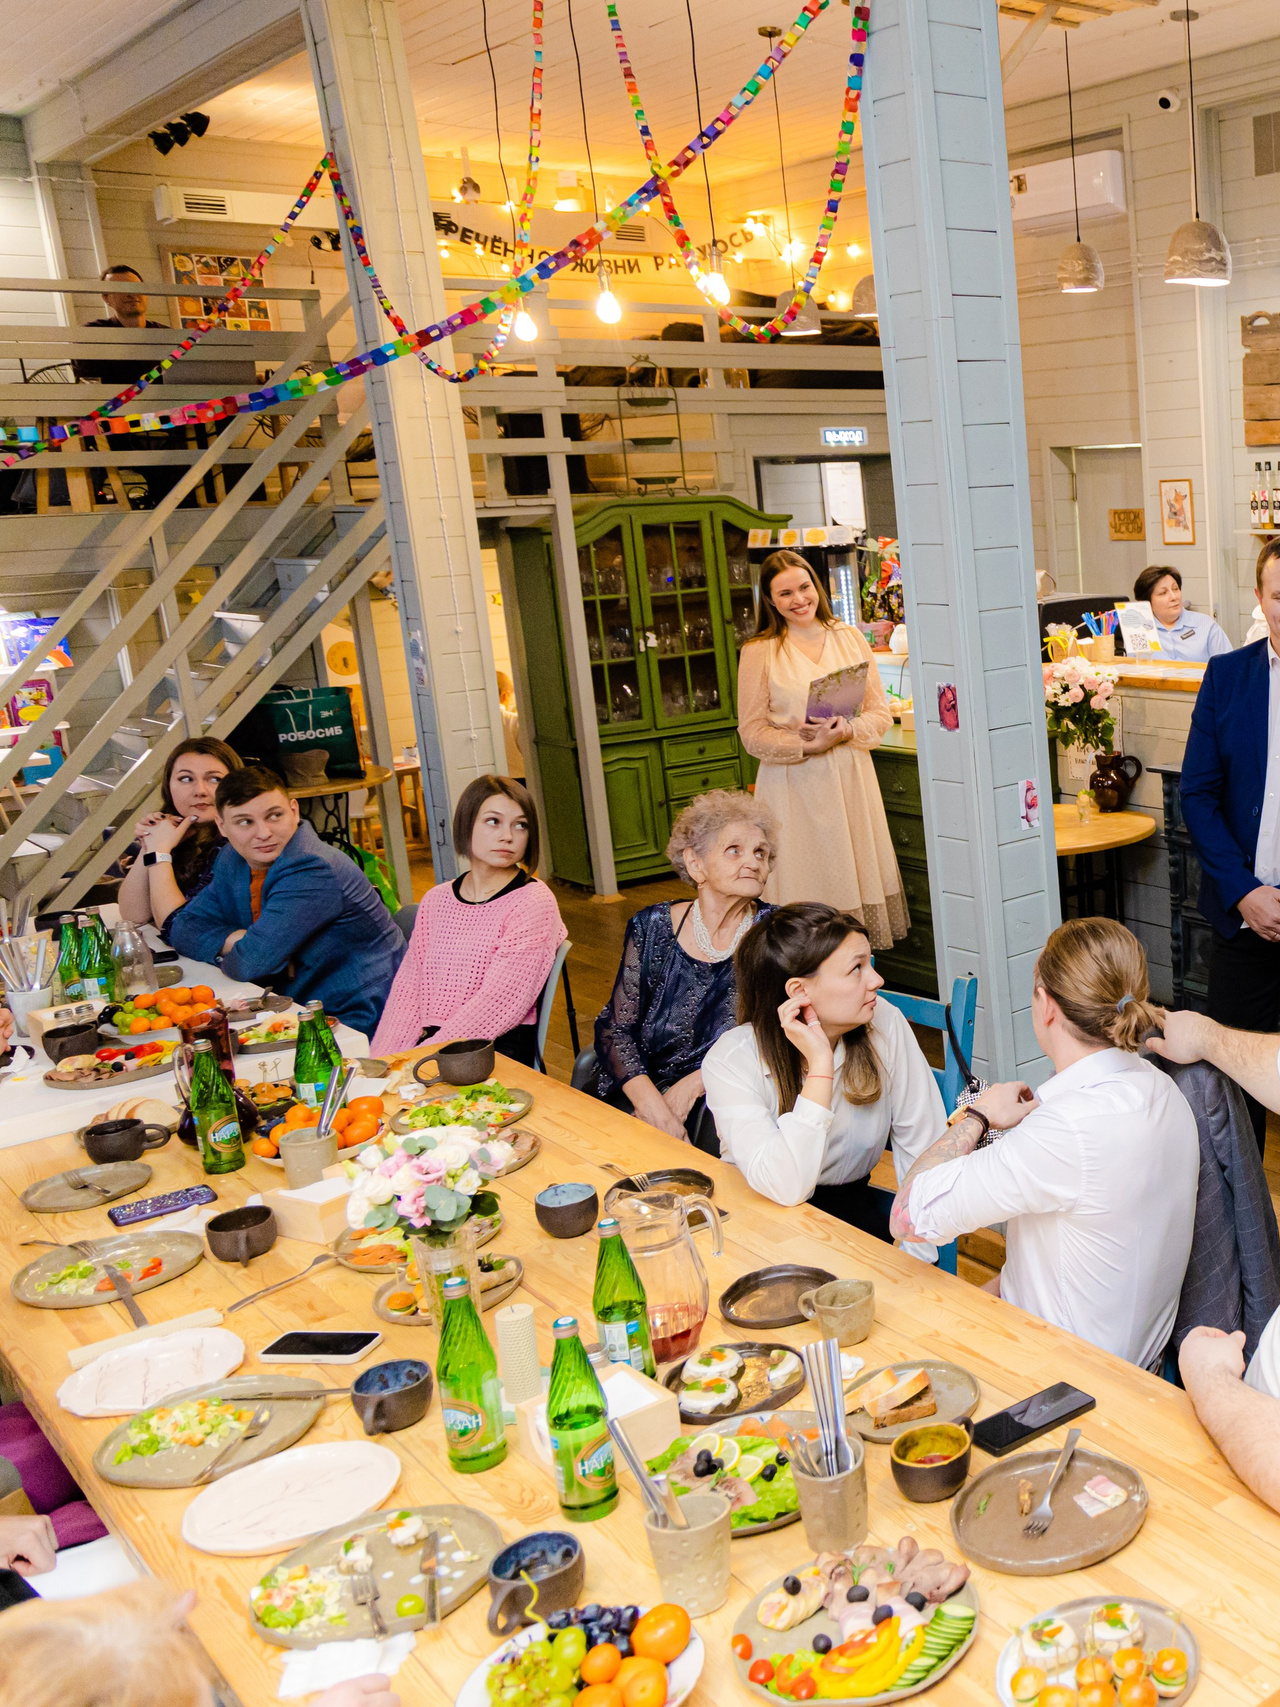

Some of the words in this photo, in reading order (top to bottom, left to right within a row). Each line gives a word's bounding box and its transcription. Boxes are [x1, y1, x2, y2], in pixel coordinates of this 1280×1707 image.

[653, 228, 754, 271] РАУЮСЬ
[278, 726, 343, 743] РОБОСИБ
[445, 1413, 483, 1430] РЗАН
